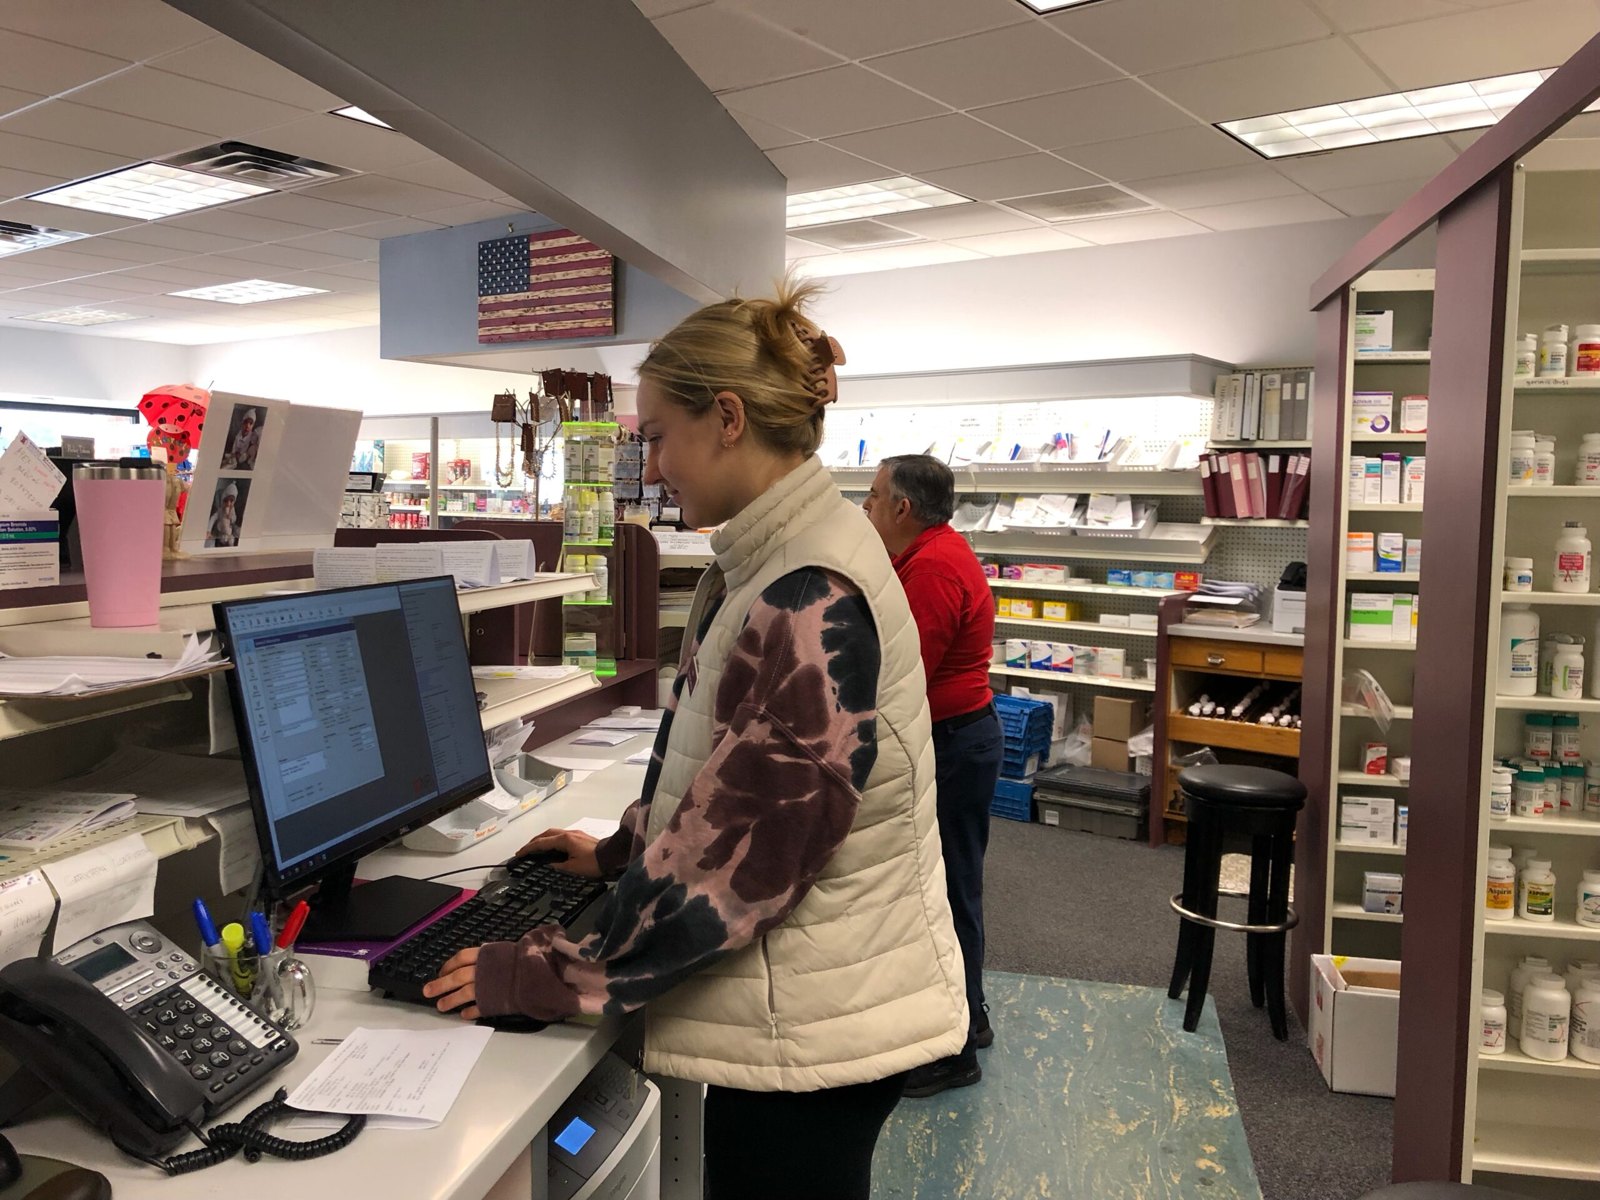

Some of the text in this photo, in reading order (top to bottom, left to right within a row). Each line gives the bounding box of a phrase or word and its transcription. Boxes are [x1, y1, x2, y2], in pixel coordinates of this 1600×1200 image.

[1488, 887, 1512, 895] Aspirin
[146, 1000, 196, 1030] 1 2 3
[165, 1013, 213, 1044] 4 5 6
[182, 1026, 231, 1059] 7 8 9
[218, 1051, 230, 1061] 0
